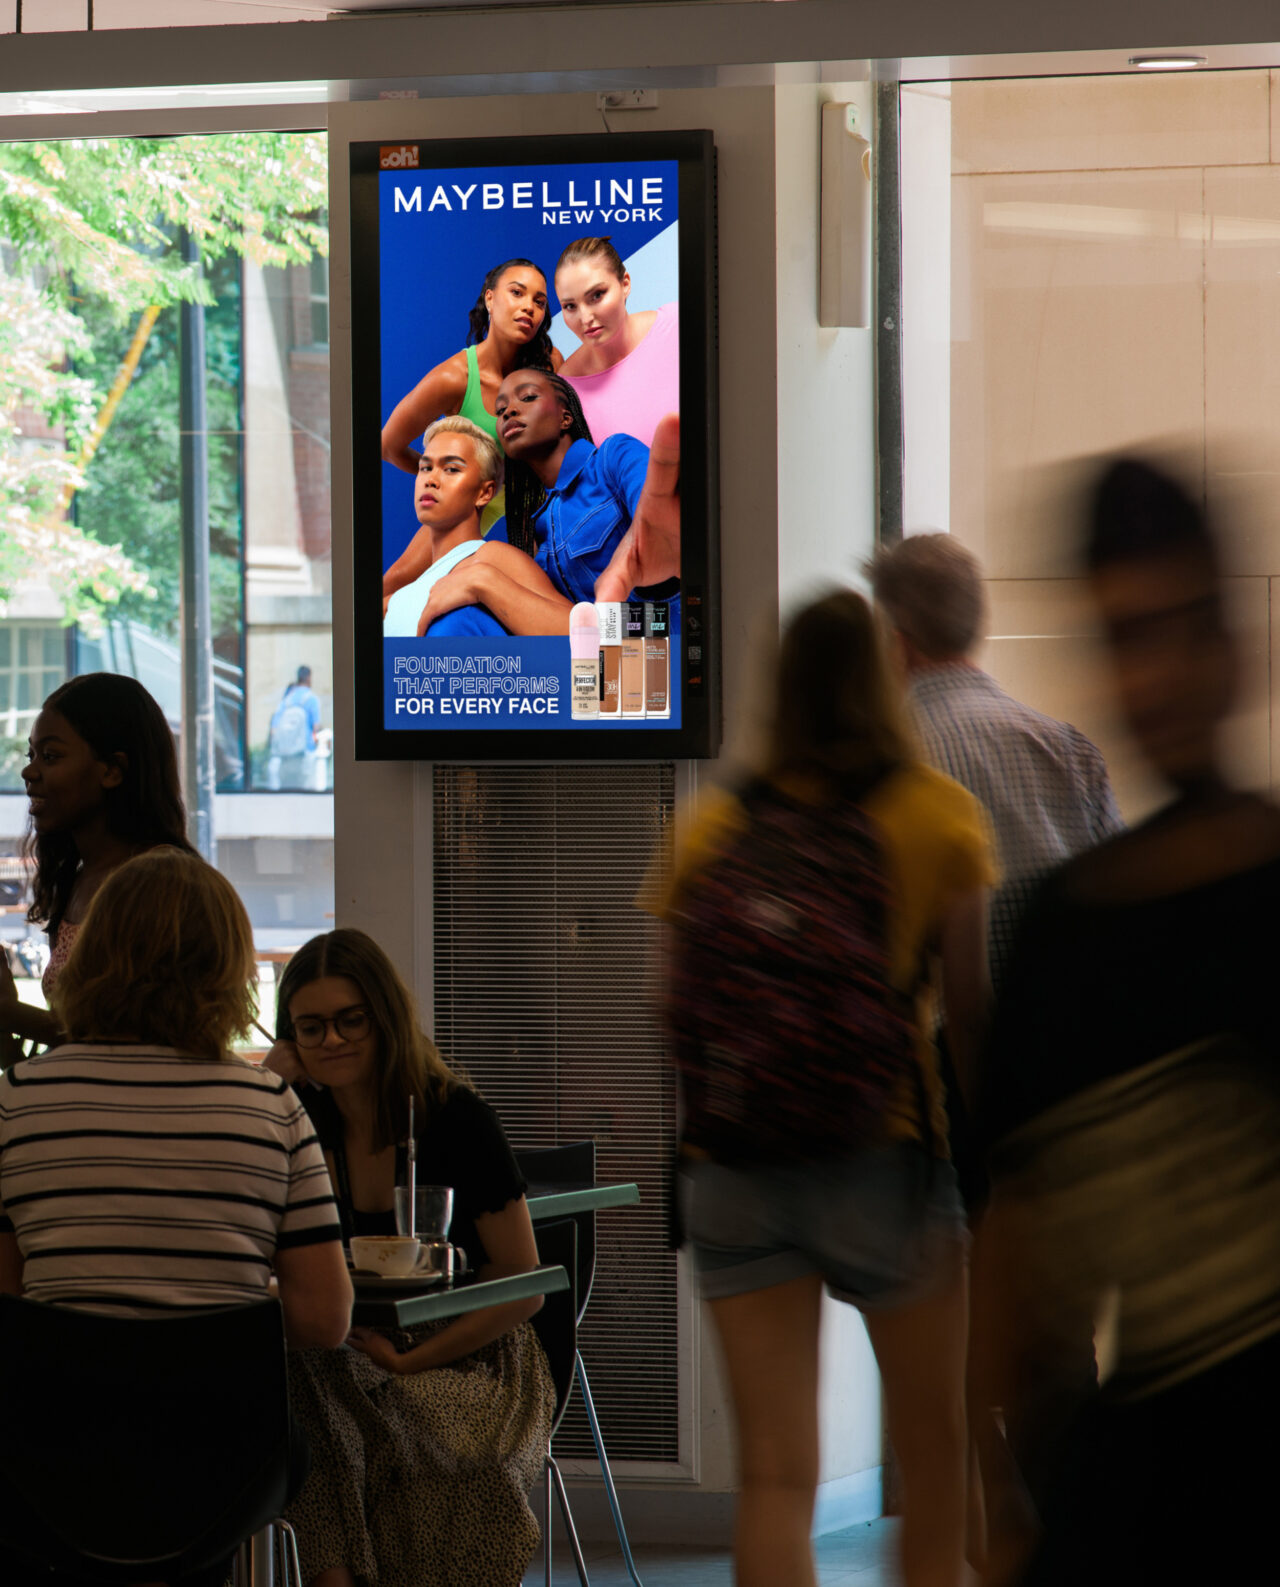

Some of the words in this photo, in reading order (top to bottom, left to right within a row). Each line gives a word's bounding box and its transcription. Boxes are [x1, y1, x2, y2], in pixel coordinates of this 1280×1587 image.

[394, 177, 663, 213] MAYBELLINE
[542, 210, 594, 225] NEW
[599, 207, 663, 223] YORK
[394, 655, 521, 674] FOUNDATION
[393, 677, 445, 695] THAT
[449, 676, 560, 695] PERFORMS
[395, 698, 434, 714] FOR
[440, 698, 503, 714] EVERY
[508, 697, 560, 714] FACE
